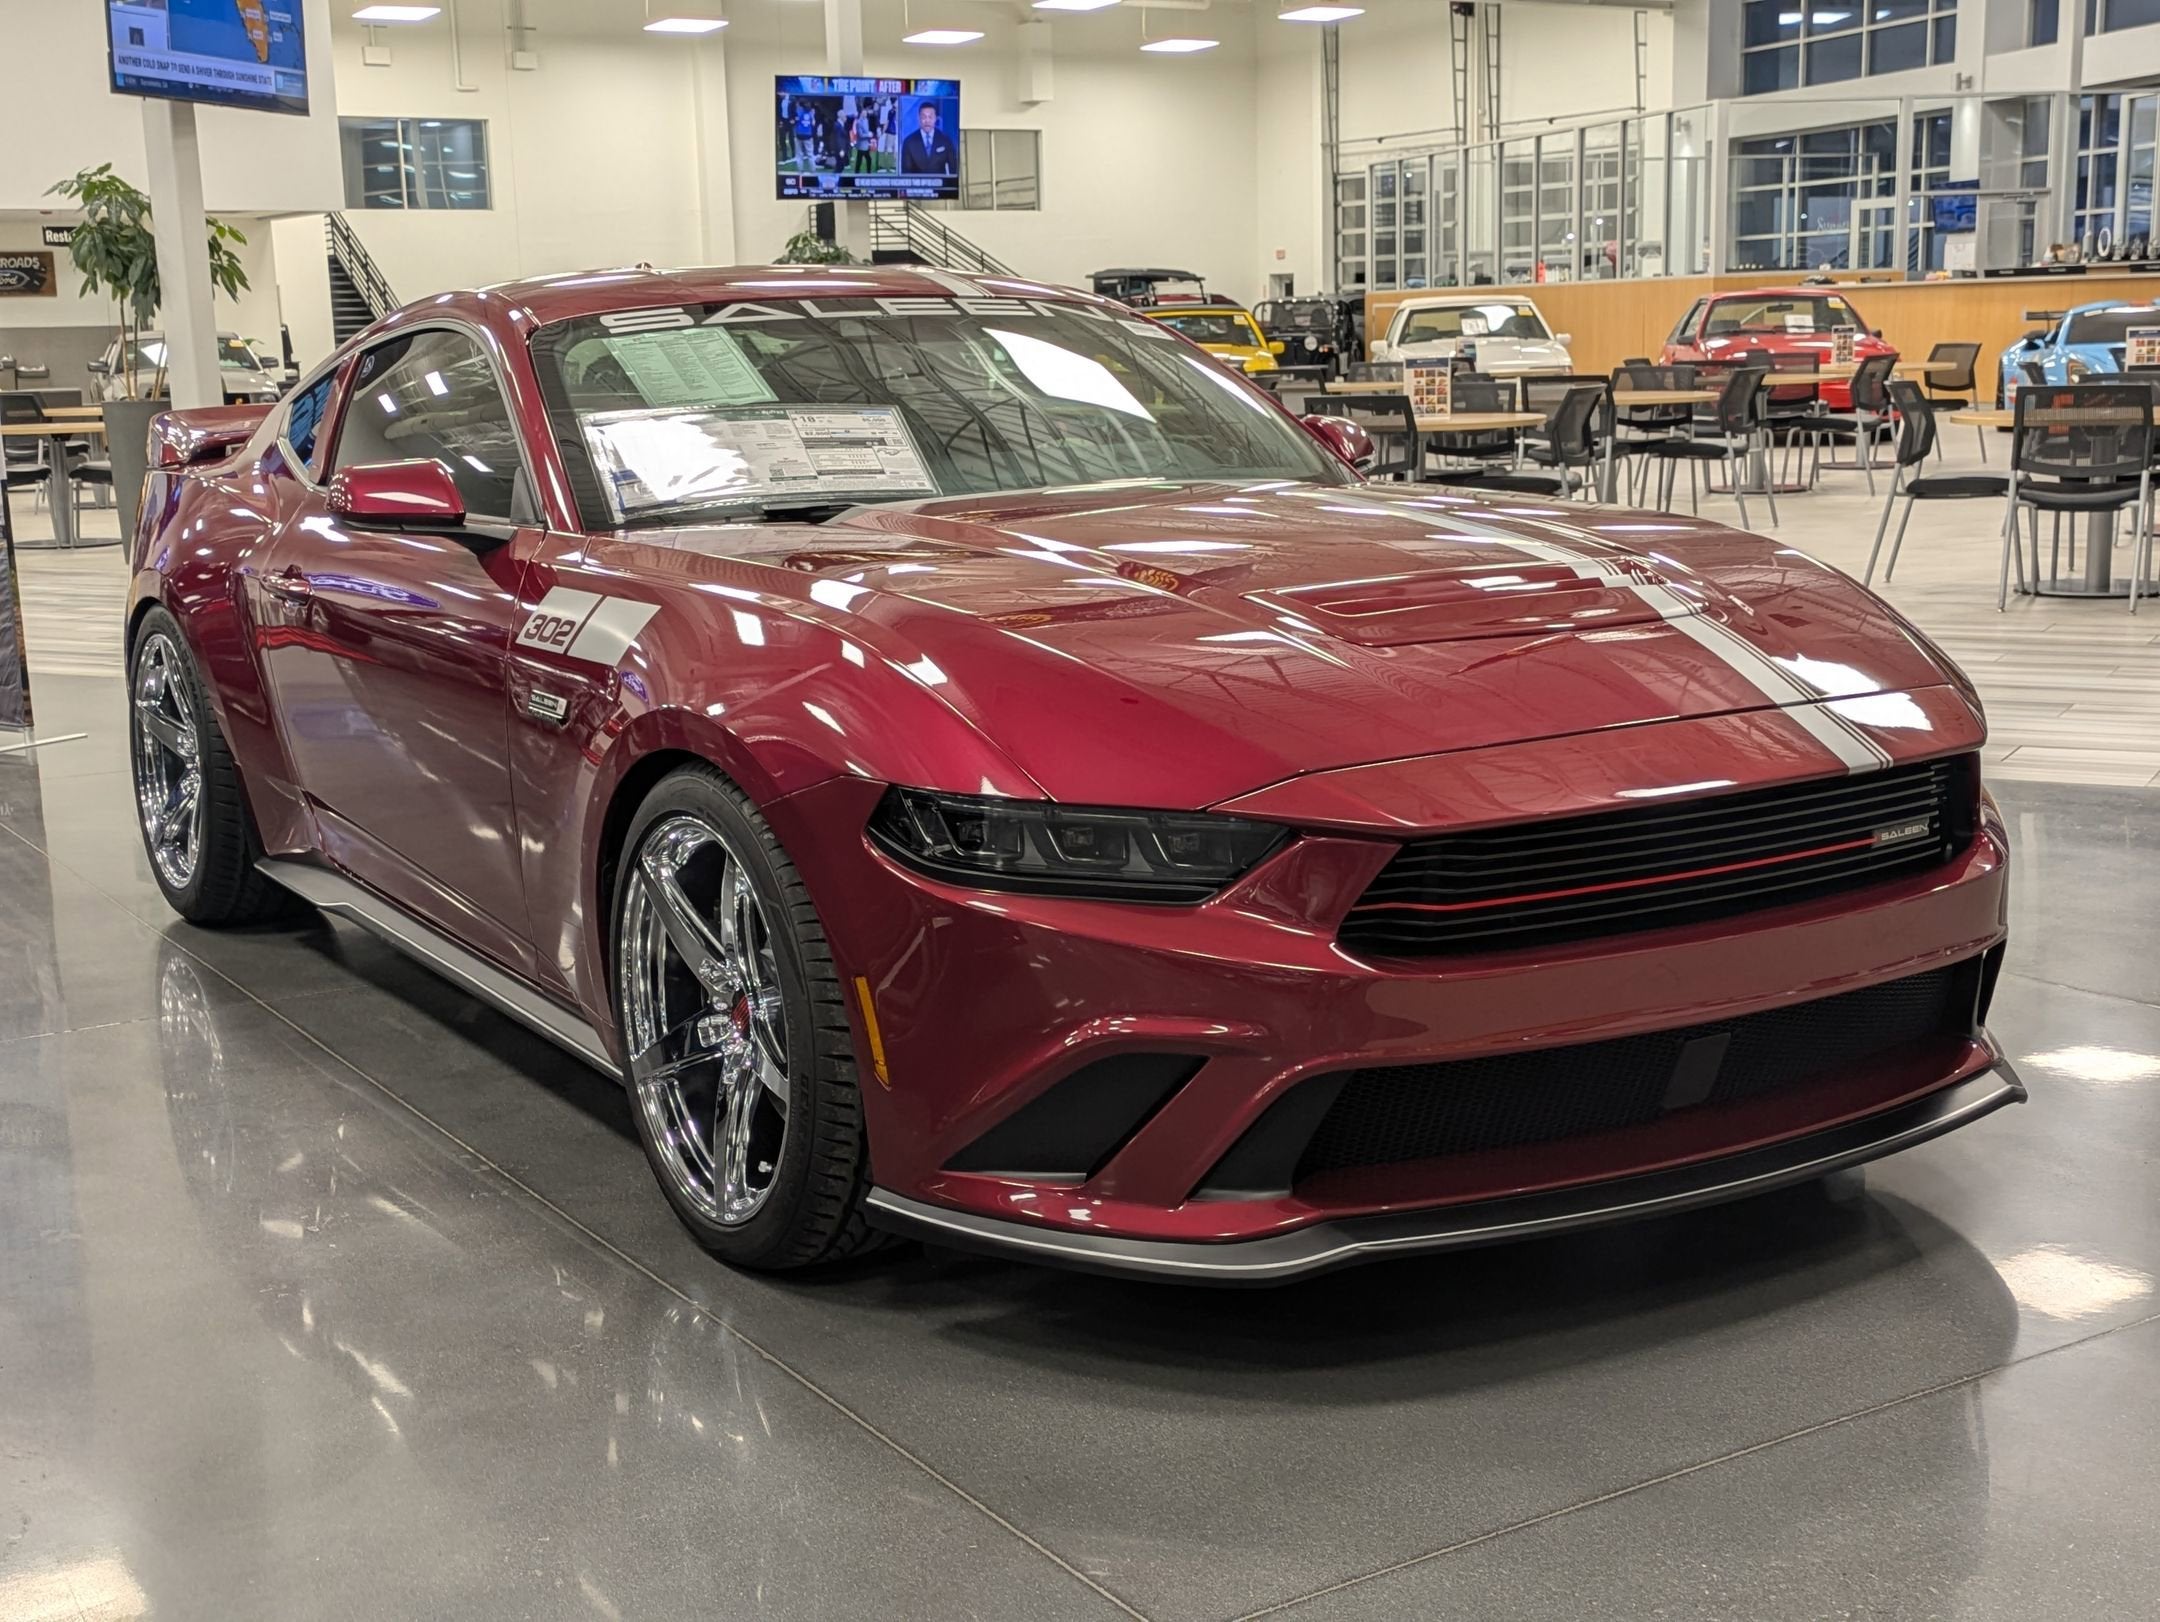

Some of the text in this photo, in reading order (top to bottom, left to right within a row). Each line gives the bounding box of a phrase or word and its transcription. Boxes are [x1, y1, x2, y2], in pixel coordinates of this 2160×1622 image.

[118, 55, 141, 67] ANOTHER
[142, 58, 156, 69] COLD
[157, 59, 169, 71] SNAP
[832, 79, 902, 93] THE POINT AFTER
[0, 257, 40, 269] ROADS
[600, 298, 1116, 334] SALEEN
[523, 614, 577, 647] 302
[1881, 823, 1928, 841] SALEEN
